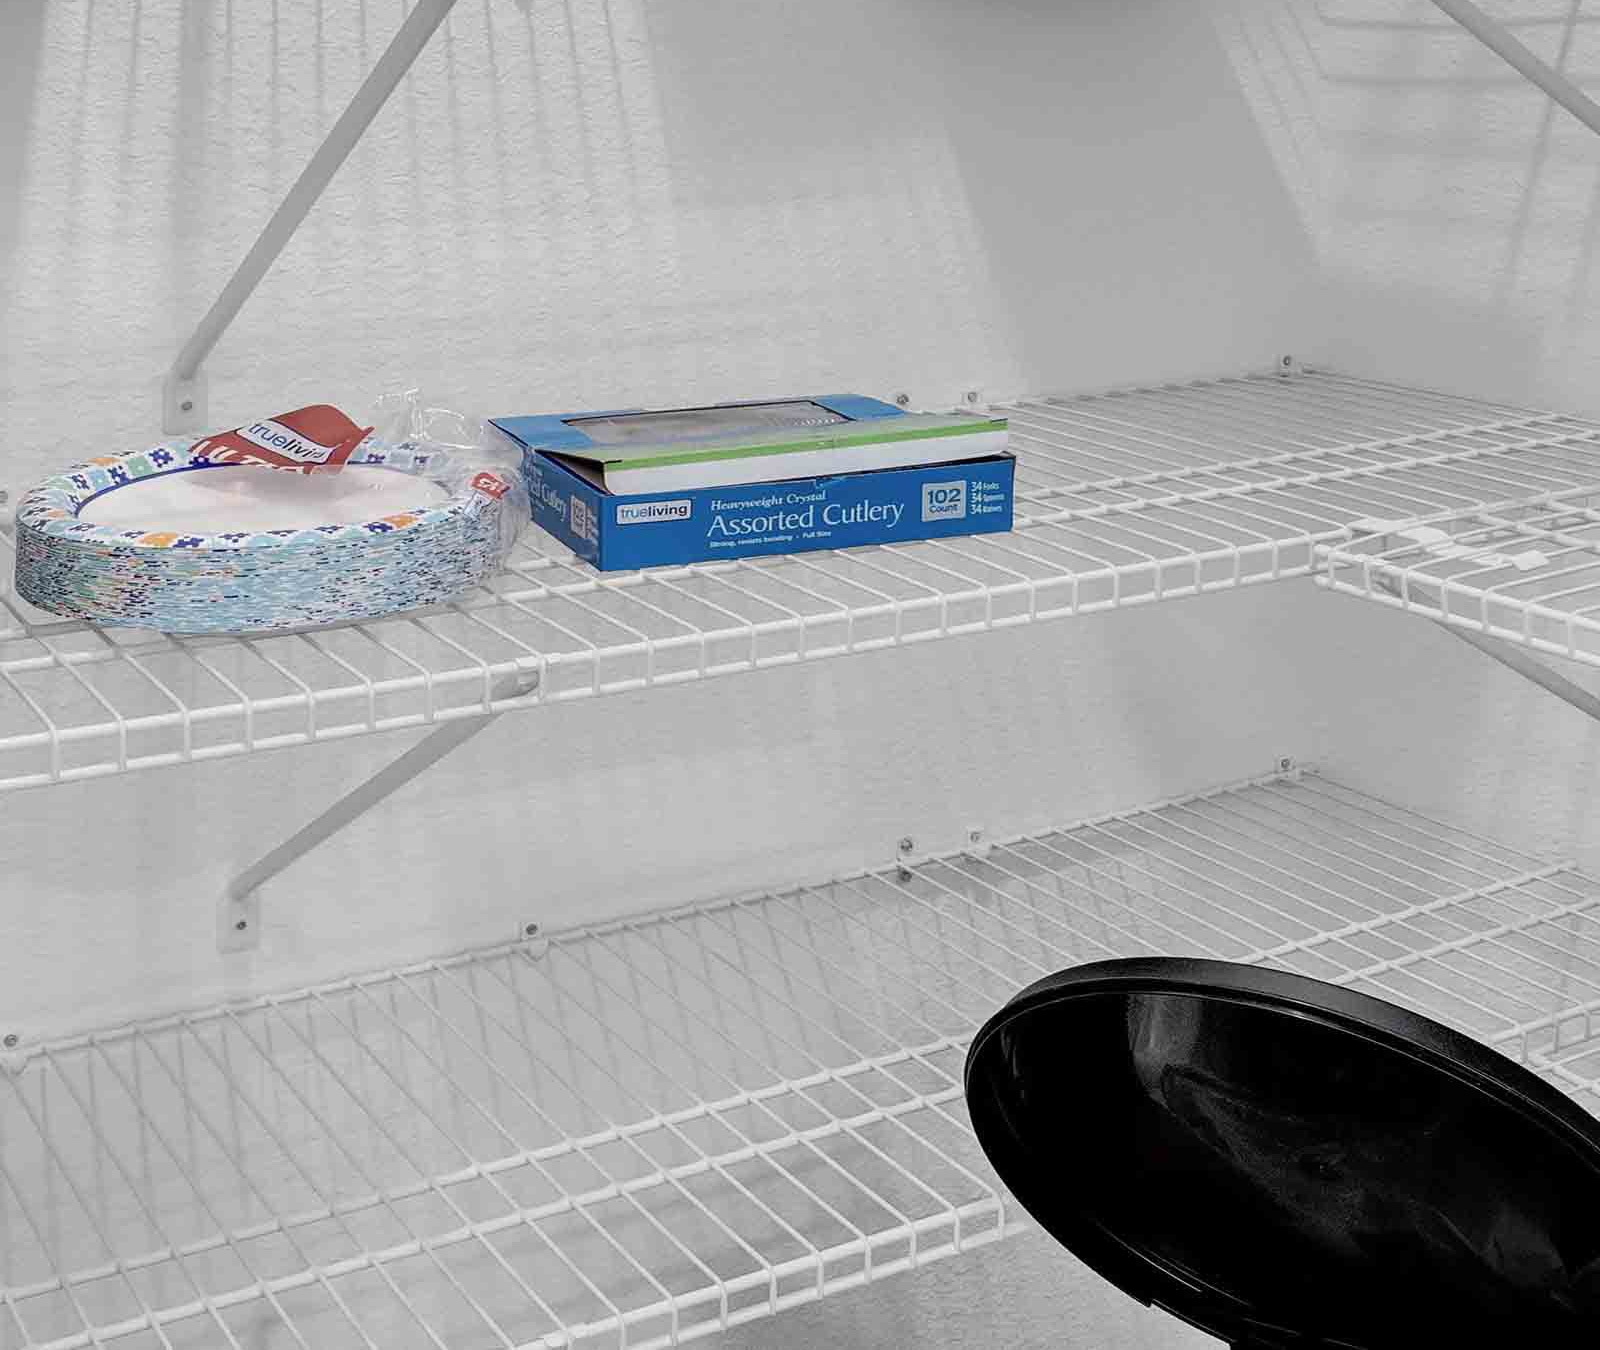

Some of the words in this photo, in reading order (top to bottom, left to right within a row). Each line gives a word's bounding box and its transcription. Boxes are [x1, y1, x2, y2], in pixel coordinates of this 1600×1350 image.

[711, 496, 783, 512] Heavyweight
[786, 490, 826, 507] Crystal
[928, 488, 961, 504] 102
[620, 504, 688, 521] trueliving
[706, 505, 815, 537] Assorted
[823, 498, 905, 528] Cutlery
[929, 504, 958, 515] Count
